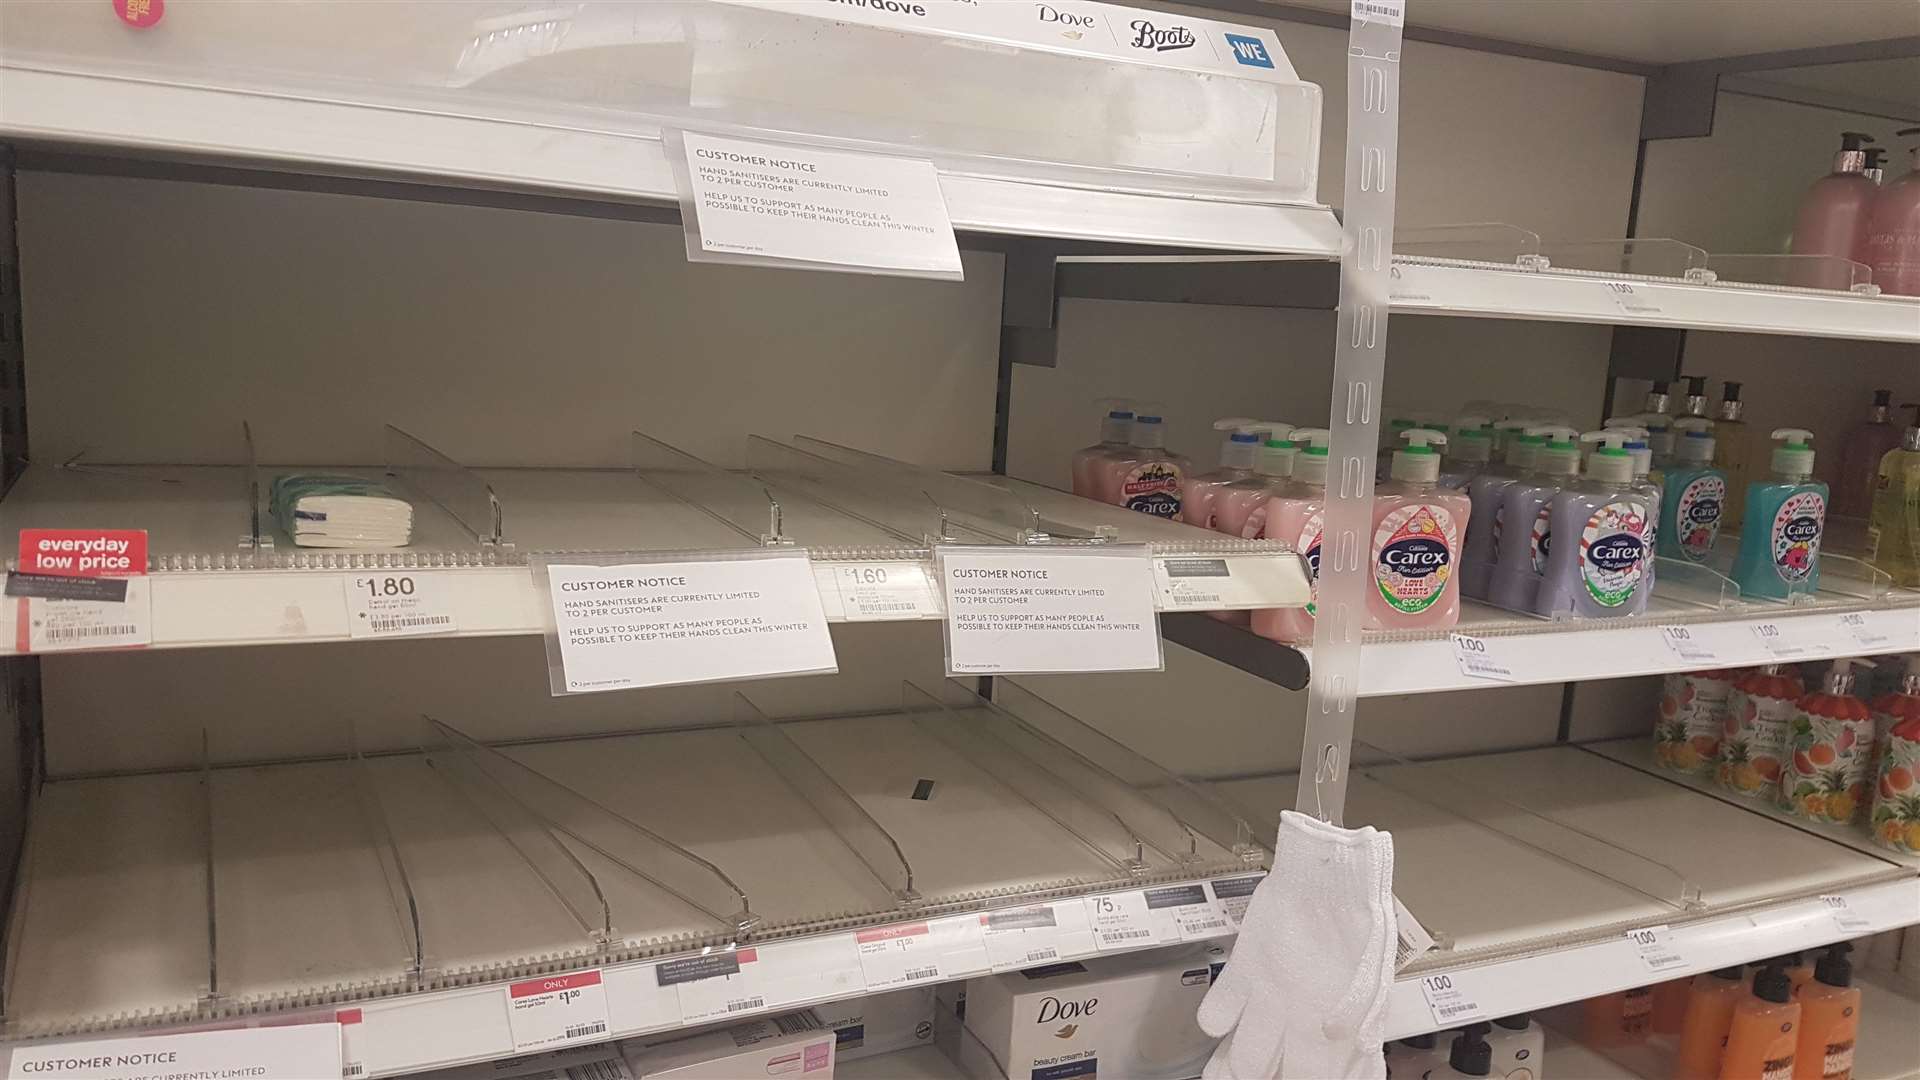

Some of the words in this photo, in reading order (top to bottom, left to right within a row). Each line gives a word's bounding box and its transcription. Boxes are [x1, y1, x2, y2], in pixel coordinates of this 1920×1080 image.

[1035, 4, 1095, 29] Dove
[1130, 19, 1196, 52] Boots
[1234, 40, 1267, 62] WE
[696, 149, 767, 167] CUSTOMER
[769, 159, 817, 173] NOTICE
[699, 166, 728, 176] HAND
[729, 169, 780, 183] SANITISERS
[783, 177, 800, 186] ARE
[801, 179, 852, 193] CURRENTLY
[855, 187, 889, 197] LIMITED
[701, 174, 715, 182] TO
[717, 176, 724, 184] 2
[725, 177, 741, 185] PER
[743, 180, 794, 192] CUSTOMER
[704, 191, 728, 201] HELP
[730, 194, 742, 203] US
[744, 196, 758, 205] TO
[760, 198, 801, 210] SUPPORT
[804, 204, 816, 212] AS
[817, 205, 843, 216] MANY
[845, 209, 877, 220] PEOPLE
[705, 200, 750, 213] POSSIBLE
[751, 206, 764, 214] TO
[766, 208, 789, 217] KEEP
[791, 210, 817, 220] THEIR
[819, 214, 850, 225] HANDS
[851, 218, 880, 228] CLEAN
[882, 222, 901, 231] THIS
[903, 224, 934, 233] WINTER
[1787, 525, 1817, 535] Carex
[38, 537, 129, 553] everyday
[1592, 545, 1640, 559] Carex
[36, 553, 73, 568] low
[79, 553, 130, 571] price
[1386, 550, 1446, 564] Carex
[953, 569, 1008, 578] CUSTOMER
[1011, 570, 1048, 579] NOTICE
[356, 576, 415, 597] £1.80
[561, 579, 634, 592] CUSTOMER
[638, 577, 687, 588] NOTICE
[1034, 588, 1076, 596] CURRENTLY
[564, 600, 594, 609] HAND
[595, 597, 648, 607] SANITISERS
[651, 595, 668, 604] ARE
[670, 593, 723, 603] CURRENTLY
[725, 591, 760, 600] LIMITED
[1402, 598, 1422, 606] eco
[566, 610, 580, 618] TO
[583, 609, 589, 617] 2
[591, 608, 608, 616] PER
[611, 605, 663, 615] CUSTOMER
[569, 626, 594, 637] HELP
[596, 625, 609, 634] US
[612, 625, 626, 633] TO
[627, 622, 670, 632] SUPPORT
[673, 621, 685, 629] AS
[687, 619, 714, 629] MANY
[716, 617, 750, 627] PEOPLE
[751, 616, 763, 624] AS
[571, 635, 616, 645] POSSIBLE
[619, 634, 633, 642] TO
[634, 632, 658, 641] KEEP
[660, 631, 686, 639] THEIR
[688, 629, 721, 639] HANDS
[722, 627, 751, 636] CLEAN
[753, 625, 774, 633] THIS
[774, 623, 808, 632] WINTER
[1097, 623, 1113, 631] THIS
[1113, 623, 1140, 631] WINTER
[1092, 898, 1114, 913] 75
[544, 979, 568, 989] ONLY
[560, 990, 580, 1004] £1.00
[1037, 996, 1098, 1025] Dove
[22, 1056, 112, 1073] CUSTOMER
[116, 1051, 177, 1067] NOTICE
[1034, 1057, 1059, 1067] beauty
[1060, 1052, 1083, 1062] cream
[1084, 1049, 1096, 1058] bar
[222, 1066, 265, 1078] LIMITED
